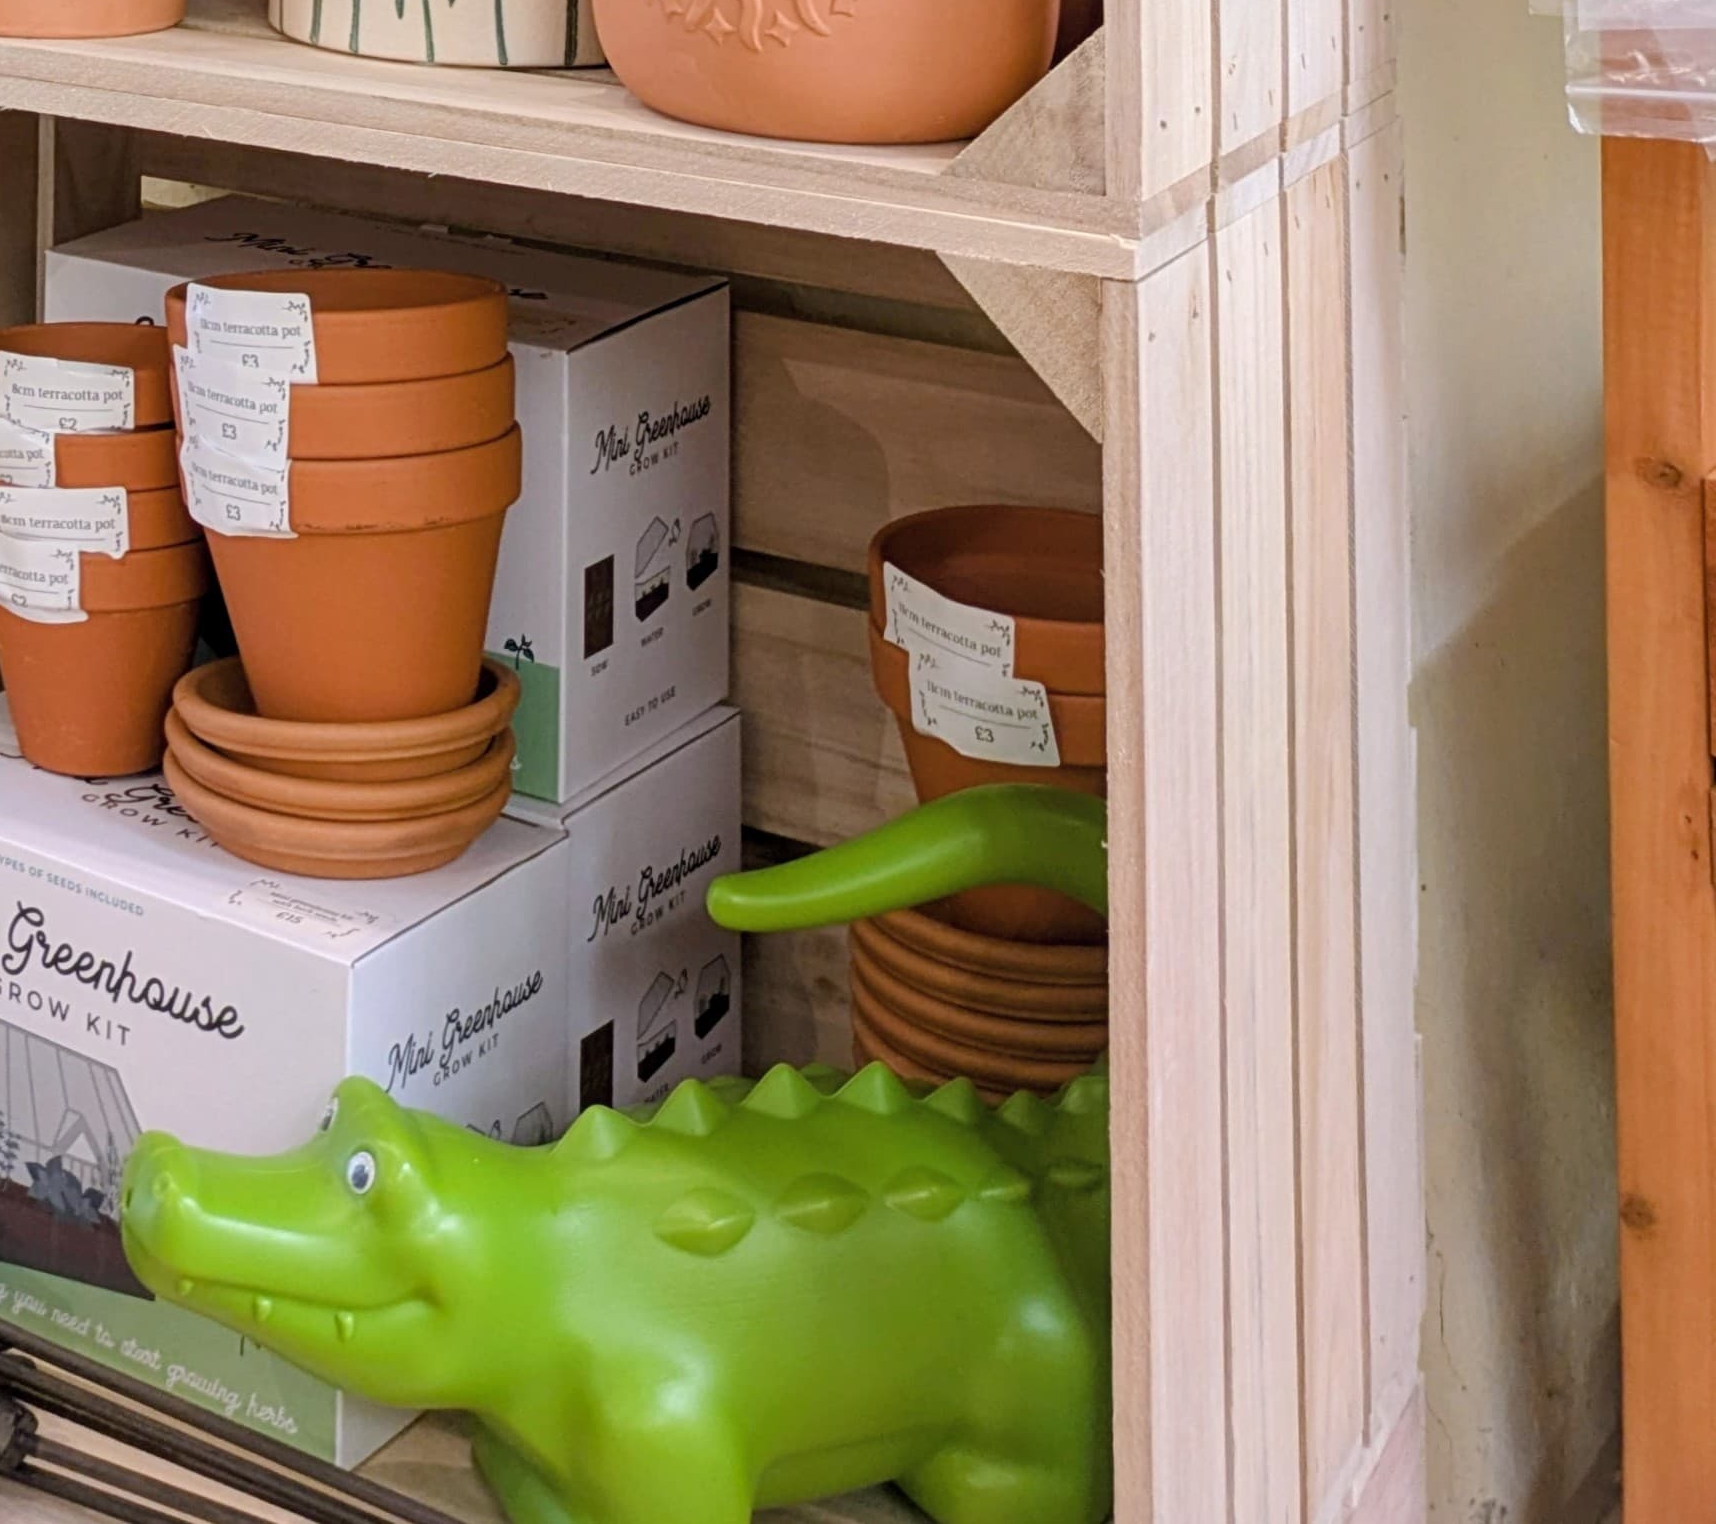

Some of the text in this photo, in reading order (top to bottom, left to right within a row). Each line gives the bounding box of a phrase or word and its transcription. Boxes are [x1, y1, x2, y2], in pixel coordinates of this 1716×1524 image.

[223, 321, 279, 337] terracotta
[281, 323, 303, 340] pot
[241, 353, 260, 368] £3
[11, 383, 124, 404] 8cm terracotta pot
[206, 387, 257, 411] terracotta
[259, 399, 279, 415] pot
[59, 416, 78, 431] £2
[221, 422, 238, 440] £3
[590, 394, 712, 475] Mini Greenhouse
[629, 441, 680, 477] GROW KIT
[208, 469, 259, 493] terracotta
[260, 479, 279, 496] pot
[0, 513, 117, 533] 8cm terracotta pot
[226, 504, 242, 521] £3
[49, 572, 69, 587] pot
[10, 593, 28, 608] £2
[640, 626, 665, 648] WATER
[921, 615, 978, 651] terracotta
[980, 641, 1002, 659] pot
[590, 658, 609, 677] SOW
[624, 685, 677, 727] EASY TO USE
[954, 690, 1014, 717] terracotta
[1016, 705, 1038, 722] pot
[974, 725, 995, 744] £3
[81, 792, 168, 828] GROW
[28, 865, 44, 879] OF
[46, 872, 83, 895] SEEDS
[85, 888, 145, 917] INCLUDED
[586, 834, 722, 943] Mini Greenhouse
[276, 910, 304, 924] £15
[630, 889, 688, 936] GROW KIT
[0, 900, 245, 1040] Greenhouse
[86, 1011, 132, 1047] KIT
[385, 969, 543, 1093] Mini Greenhouse
[433, 1032, 500, 1087] GROW KIT
[13, 1288, 48, 1316] you
[51, 1306, 92, 1336] need
[95, 1320, 115, 1349] to
[120, 1334, 162, 1371] start
[166, 1363, 242, 1417] growing
[245, 1390, 299, 1435] herbs
